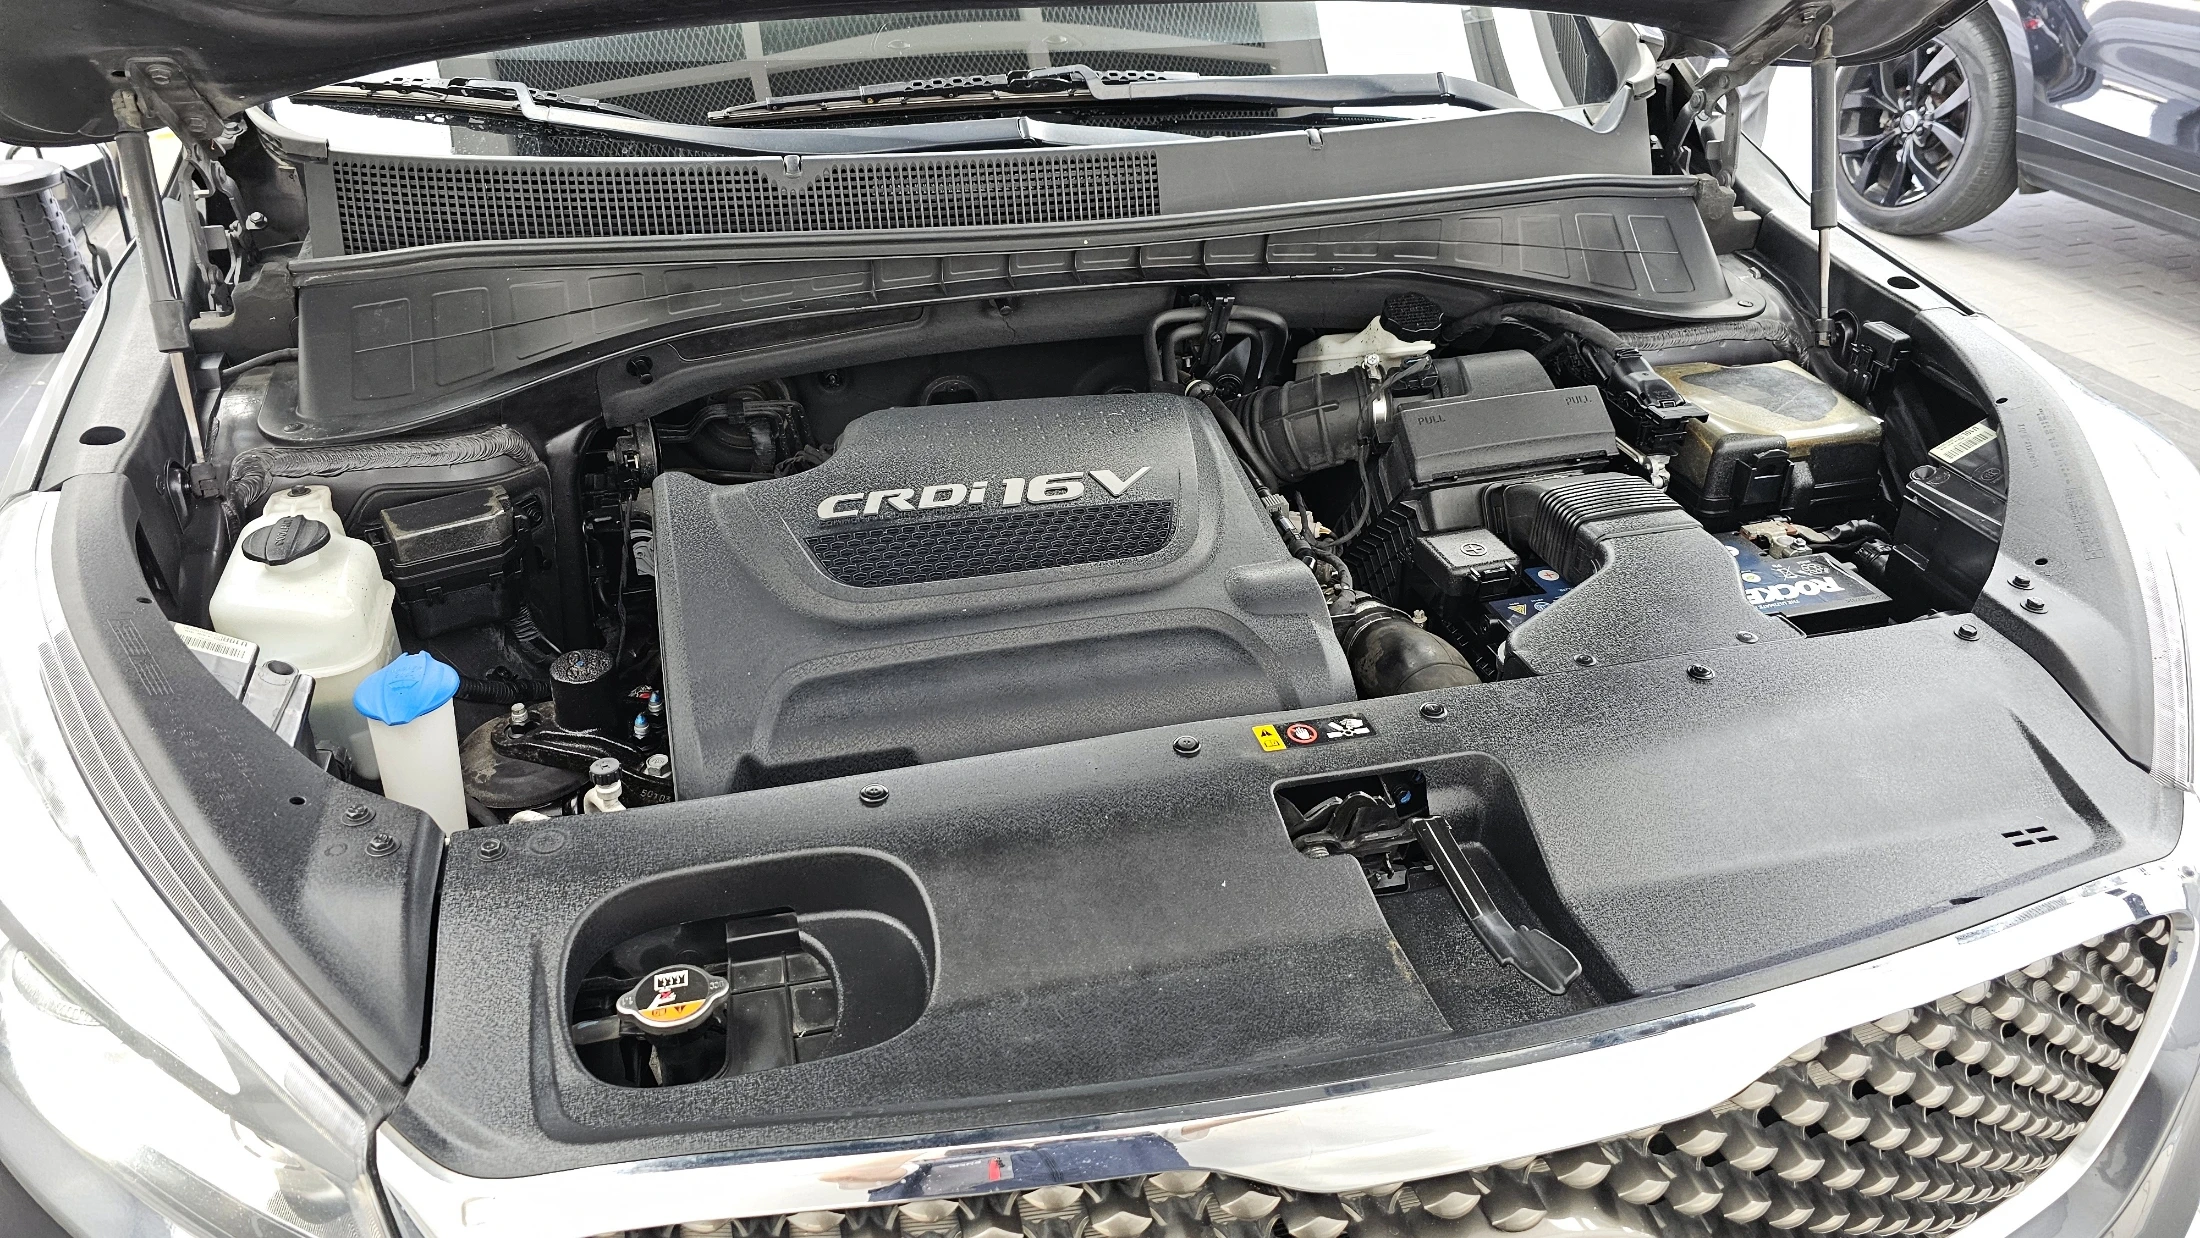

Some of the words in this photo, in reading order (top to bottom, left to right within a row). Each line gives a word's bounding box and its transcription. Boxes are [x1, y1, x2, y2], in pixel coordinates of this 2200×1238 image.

[1564, 394, 1592, 406] PULL
[1417, 414, 1446, 426] PULL
[817, 481, 989, 521] CRDi
[1001, 466, 1152, 509] 16V
[275, 520, 293, 546] COOLANT
